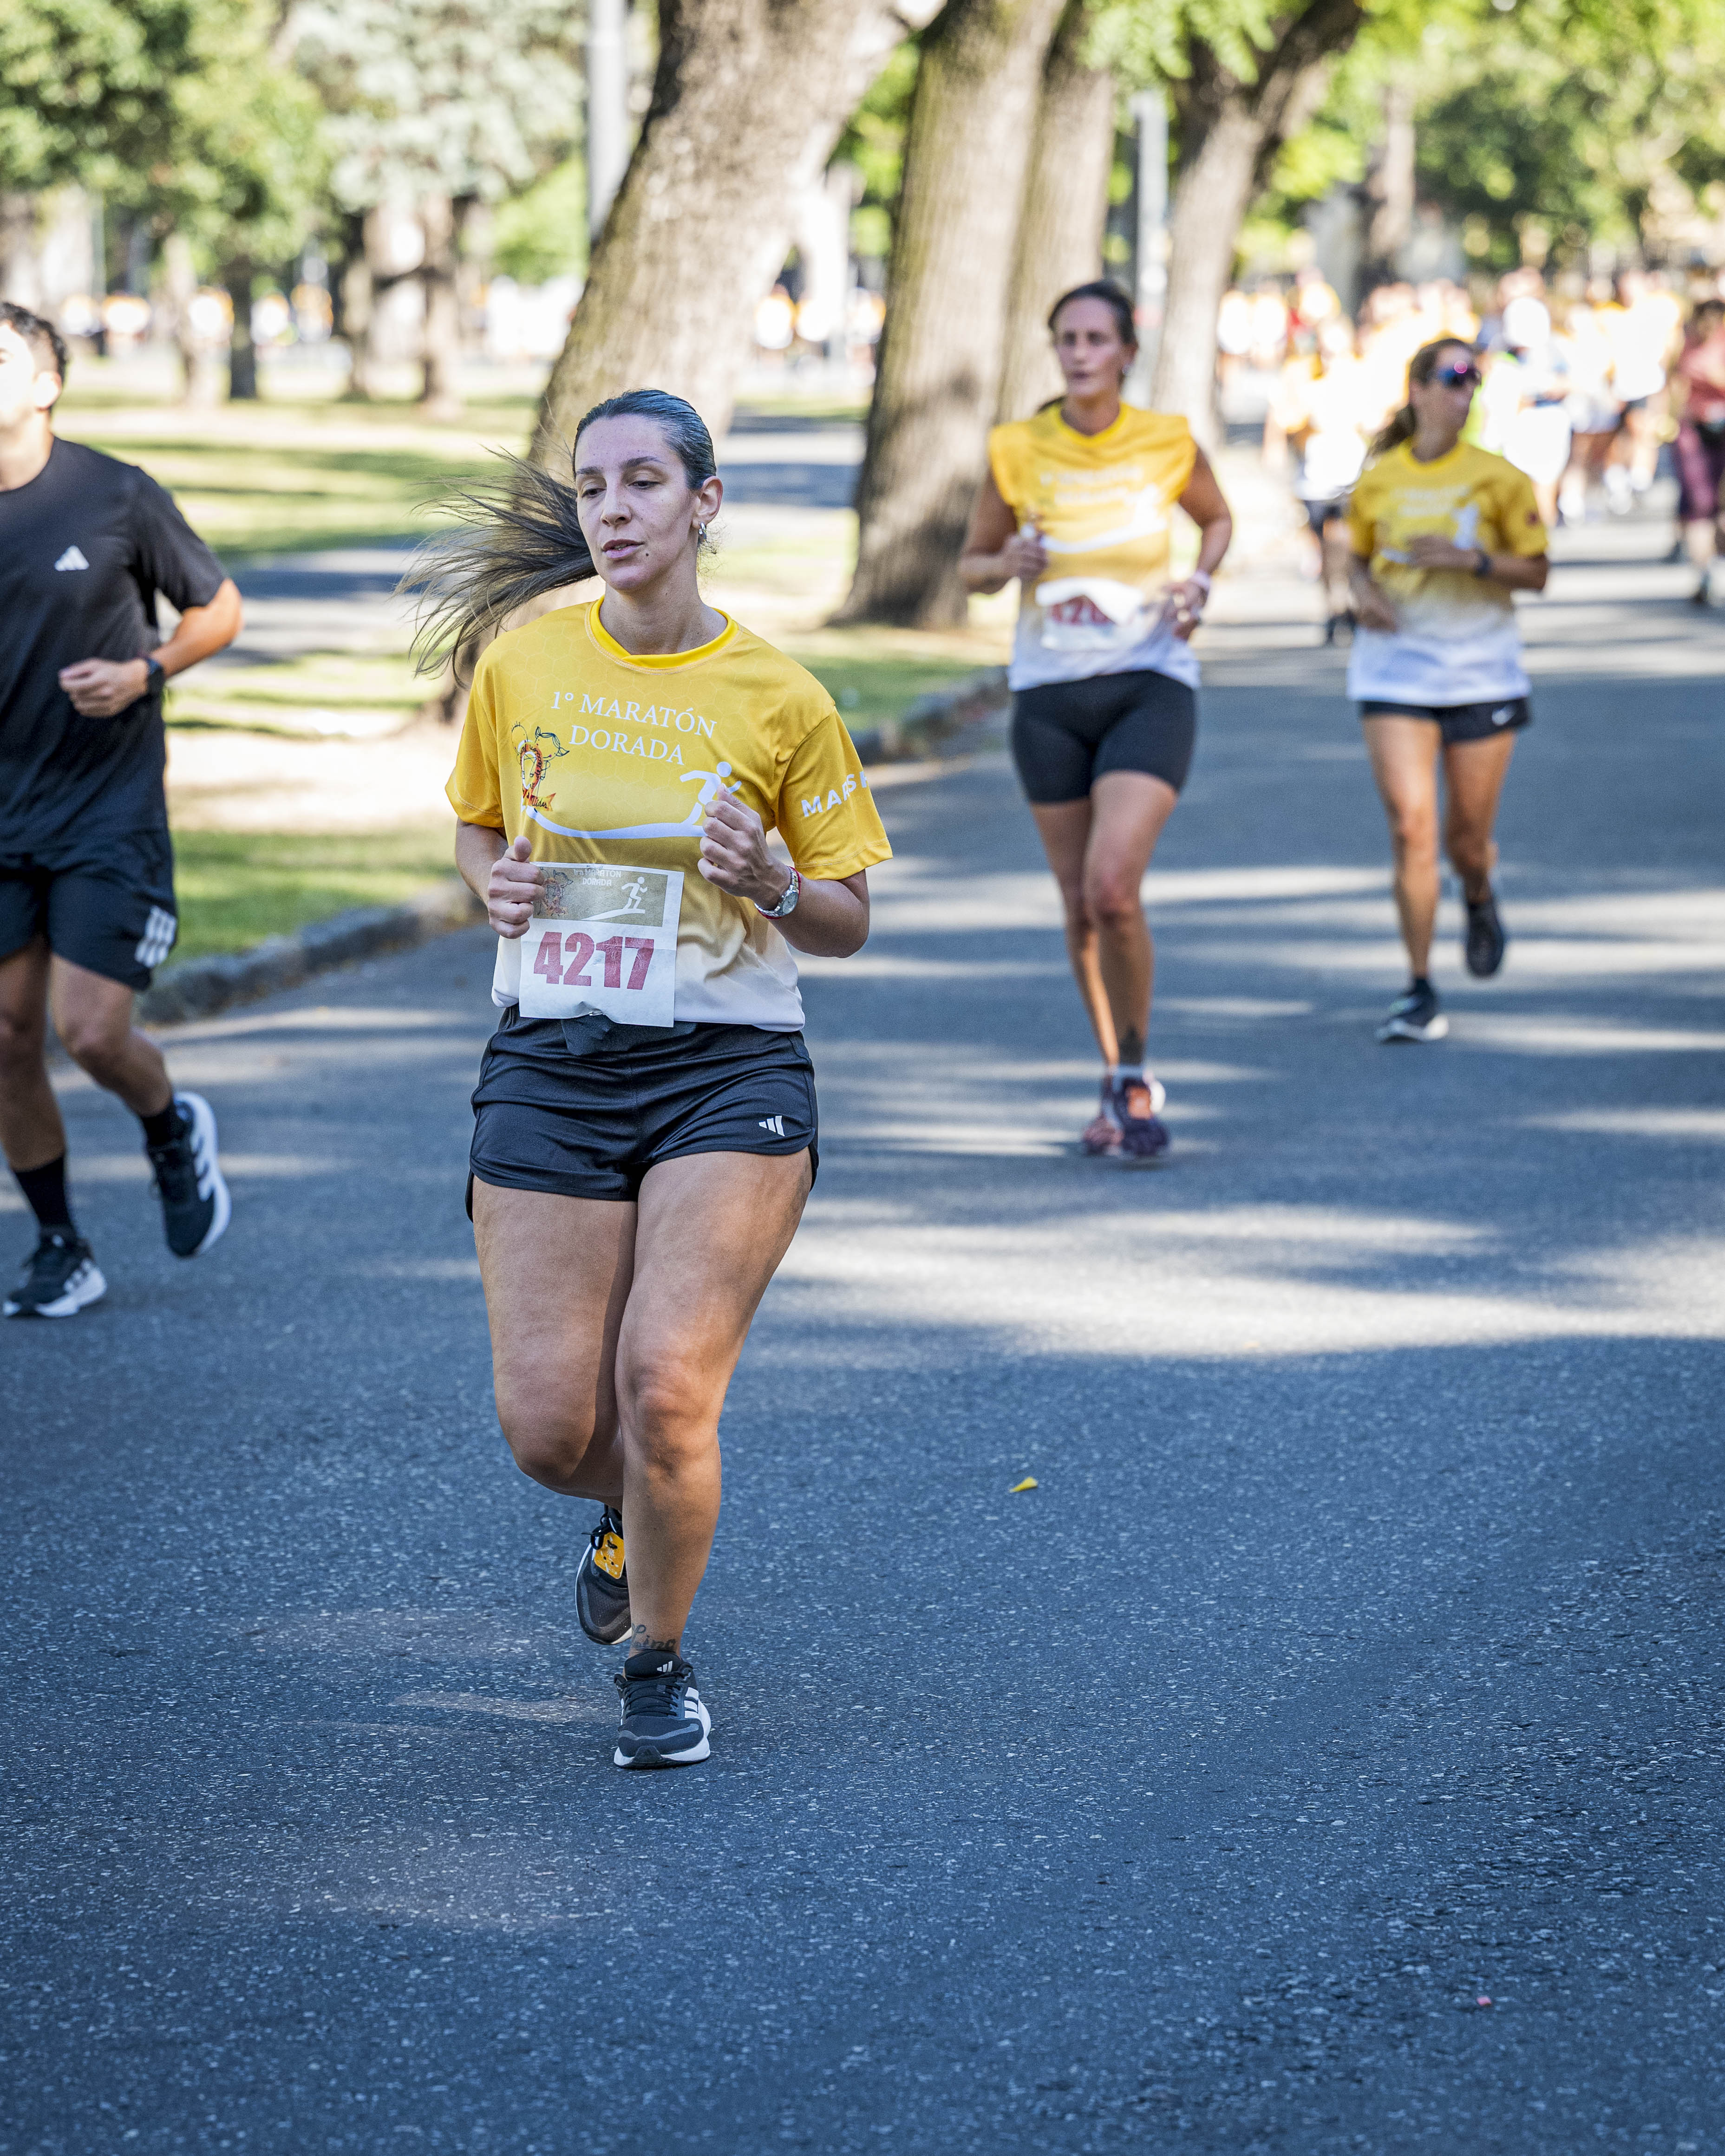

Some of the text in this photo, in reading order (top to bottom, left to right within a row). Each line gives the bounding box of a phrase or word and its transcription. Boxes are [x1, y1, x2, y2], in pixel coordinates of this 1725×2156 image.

[579, 693, 717, 738] MARATÓN
[569, 725, 684, 765] DORADA
[582, 878, 612, 886] DORADA
[534, 931, 654, 990] 4217
